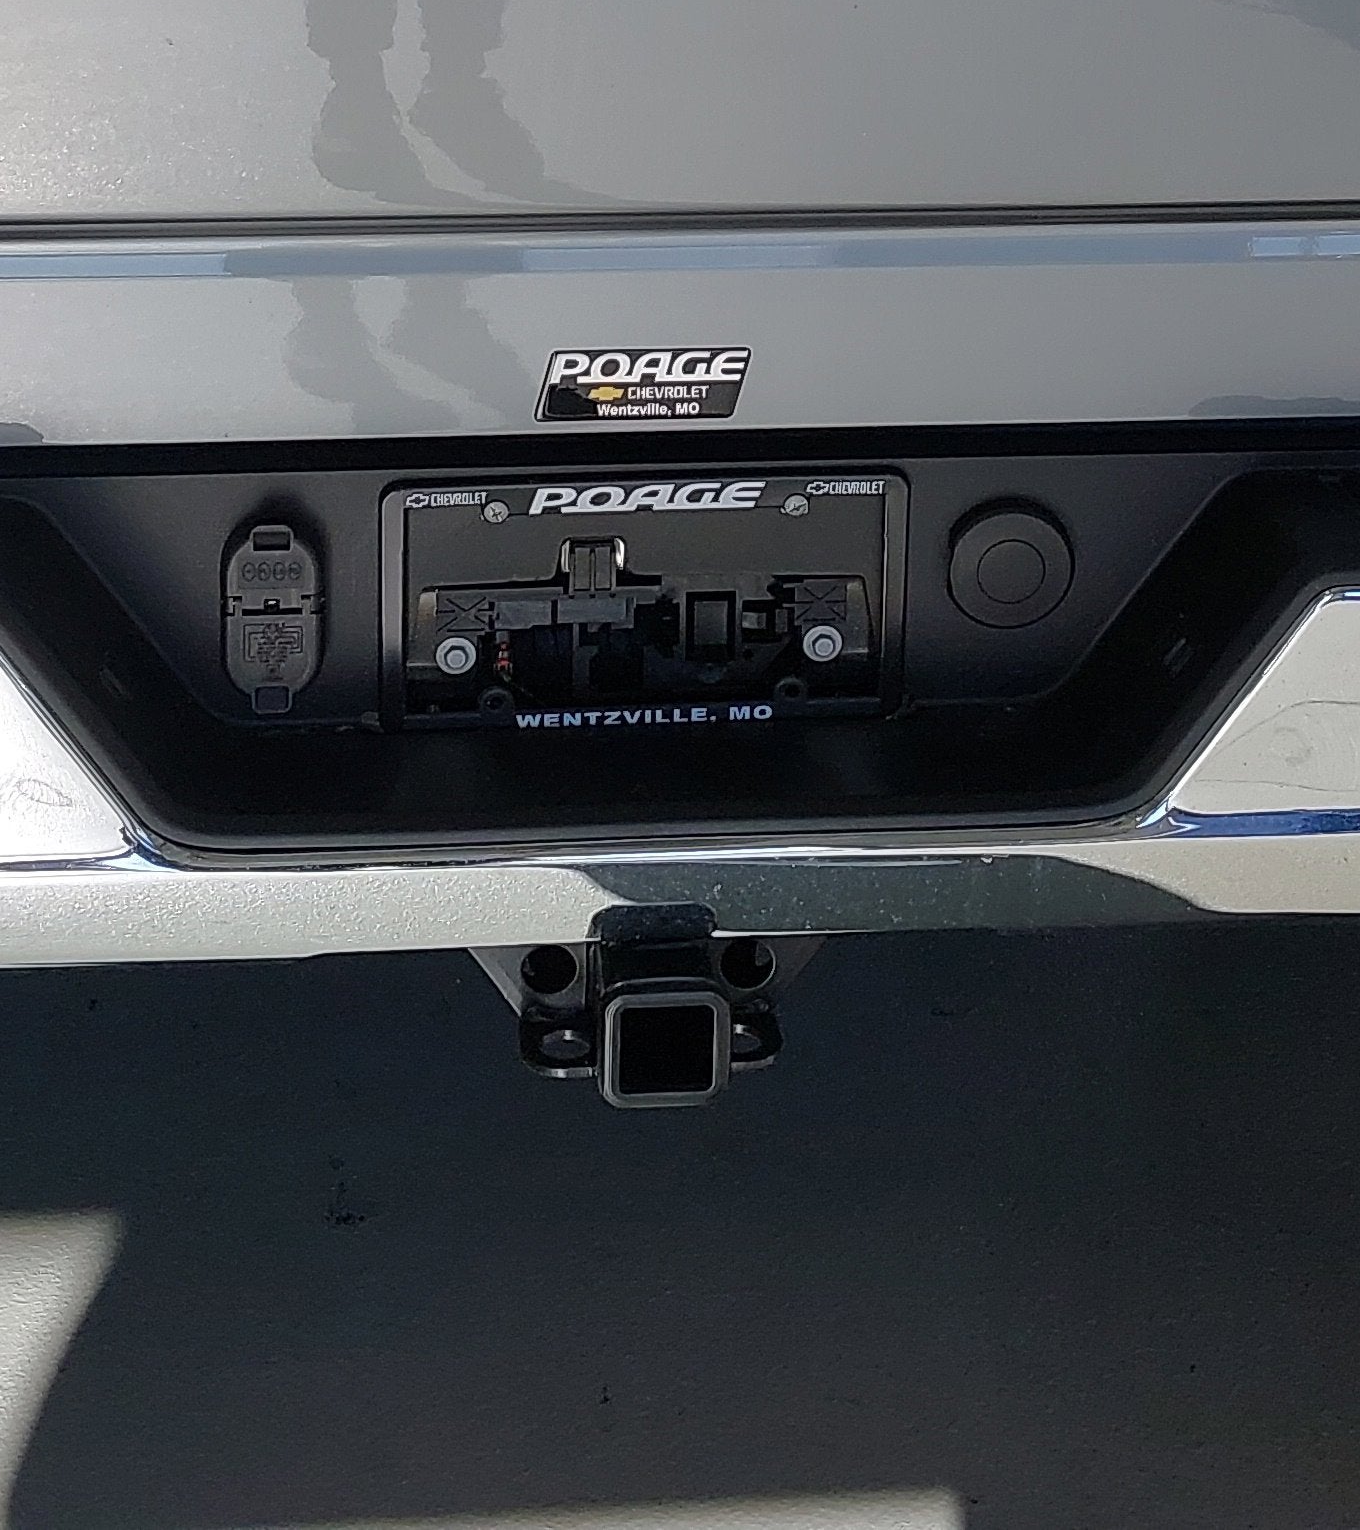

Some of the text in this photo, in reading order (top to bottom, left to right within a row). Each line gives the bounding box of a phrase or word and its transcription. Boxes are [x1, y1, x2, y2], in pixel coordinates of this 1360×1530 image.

[548, 349, 749, 385] POAGE
[627, 385, 710, 400] CHEVROLET
[597, 402, 700, 417] Wentzville, MO
[828, 480, 886, 495] CHEVROLET
[430, 491, 488, 507] CHEVROLET
[528, 480, 766, 517] POAGE
[515, 705, 773, 730] WENTZVILLE, MO
